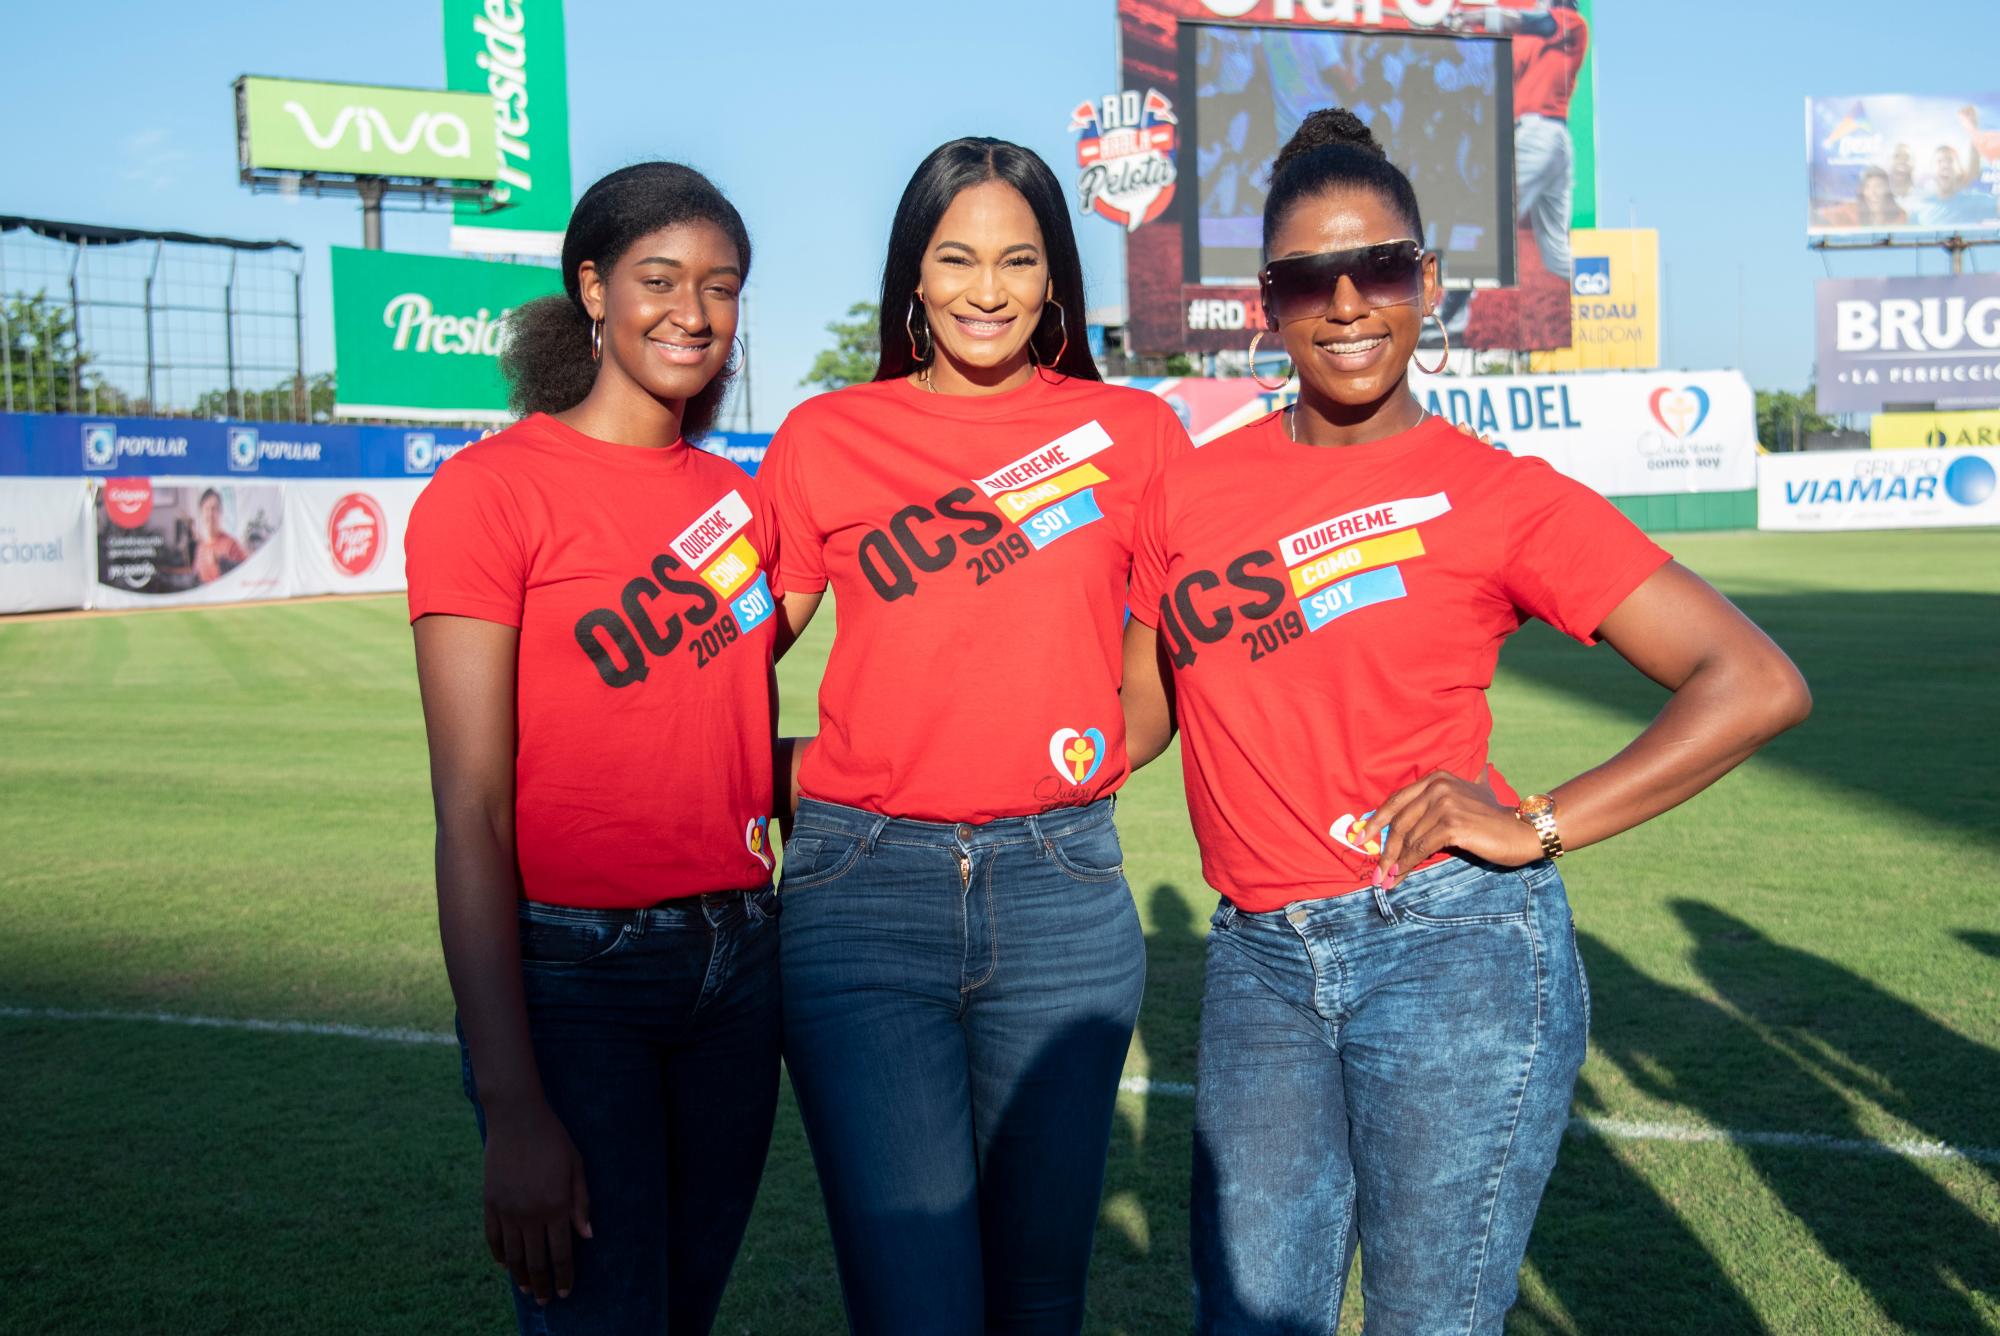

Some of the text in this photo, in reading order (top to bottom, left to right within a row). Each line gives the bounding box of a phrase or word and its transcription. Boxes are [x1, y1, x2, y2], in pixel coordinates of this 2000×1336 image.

[1836, 297, 2000, 351] BRUG
[1509, 384, 1582, 432] DEL
[117, 436, 188, 457] POPULAR
[259, 440, 322, 461] POPULAR
[1956, 426, 2000, 446] AR
[985, 444, 1070, 490] QUIEREME
[1784, 476, 1938, 505] VIAMAR
[680, 509, 733, 560] QUIEREME
[858, 487, 1004, 602] QCS
[1031, 505, 1073, 538] SOY
[1292, 507, 1397, 556] QUIEREME
[709, 552, 746, 590] COMO
[966, 533, 1030, 586] 2019
[1301, 548, 1362, 587] COMO
[574, 553, 718, 688] QCS
[739, 586, 769, 622] SOY
[1311, 582, 1354, 619] SOY
[688, 614, 739, 669] 2019
[1241, 610, 1304, 663] 2019
